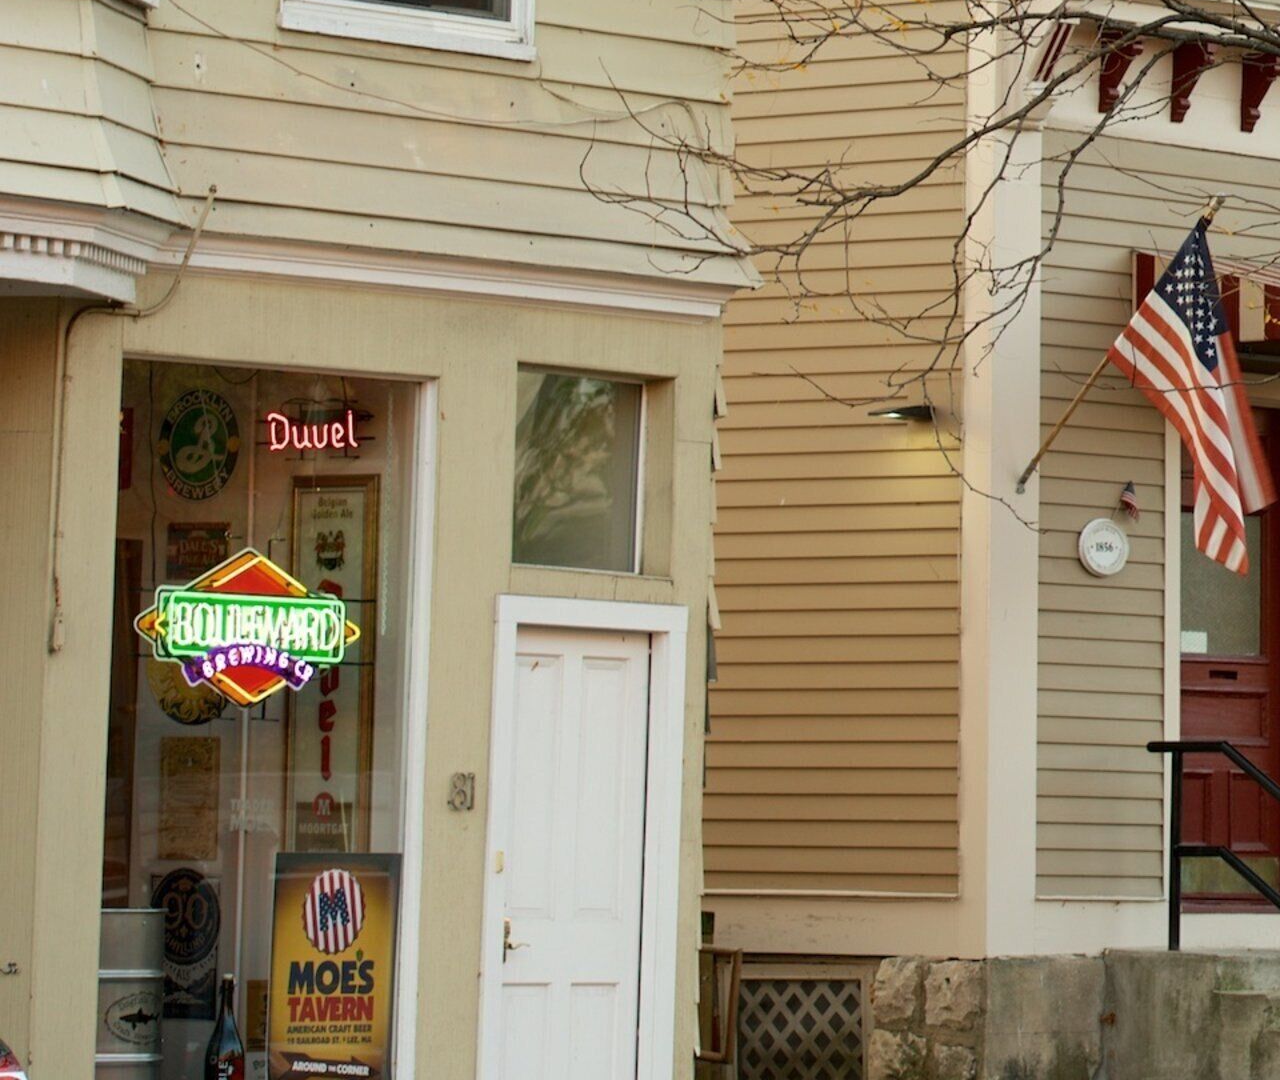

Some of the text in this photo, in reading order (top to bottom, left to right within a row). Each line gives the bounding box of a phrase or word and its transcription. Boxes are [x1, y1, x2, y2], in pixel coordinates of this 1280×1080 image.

[167, 391, 233, 423] BROOKLYN
[268, 409, 358, 451] Duvel
[166, 467, 228, 499] BREWERY
[1096, 542, 1114, 552] 1856
[202, 645, 289, 678] BREWING
[447, 772, 475, 811] 81
[318, 886, 350, 933] M
[287, 956, 375, 995] MOE'S
[287, 996, 374, 1022] TAVERN
[287, 1024, 372, 1034] AMERICAN CRAFT BEER
[292, 1060, 327, 1073] AROUND
[337, 1064, 370, 1076] CORNER
